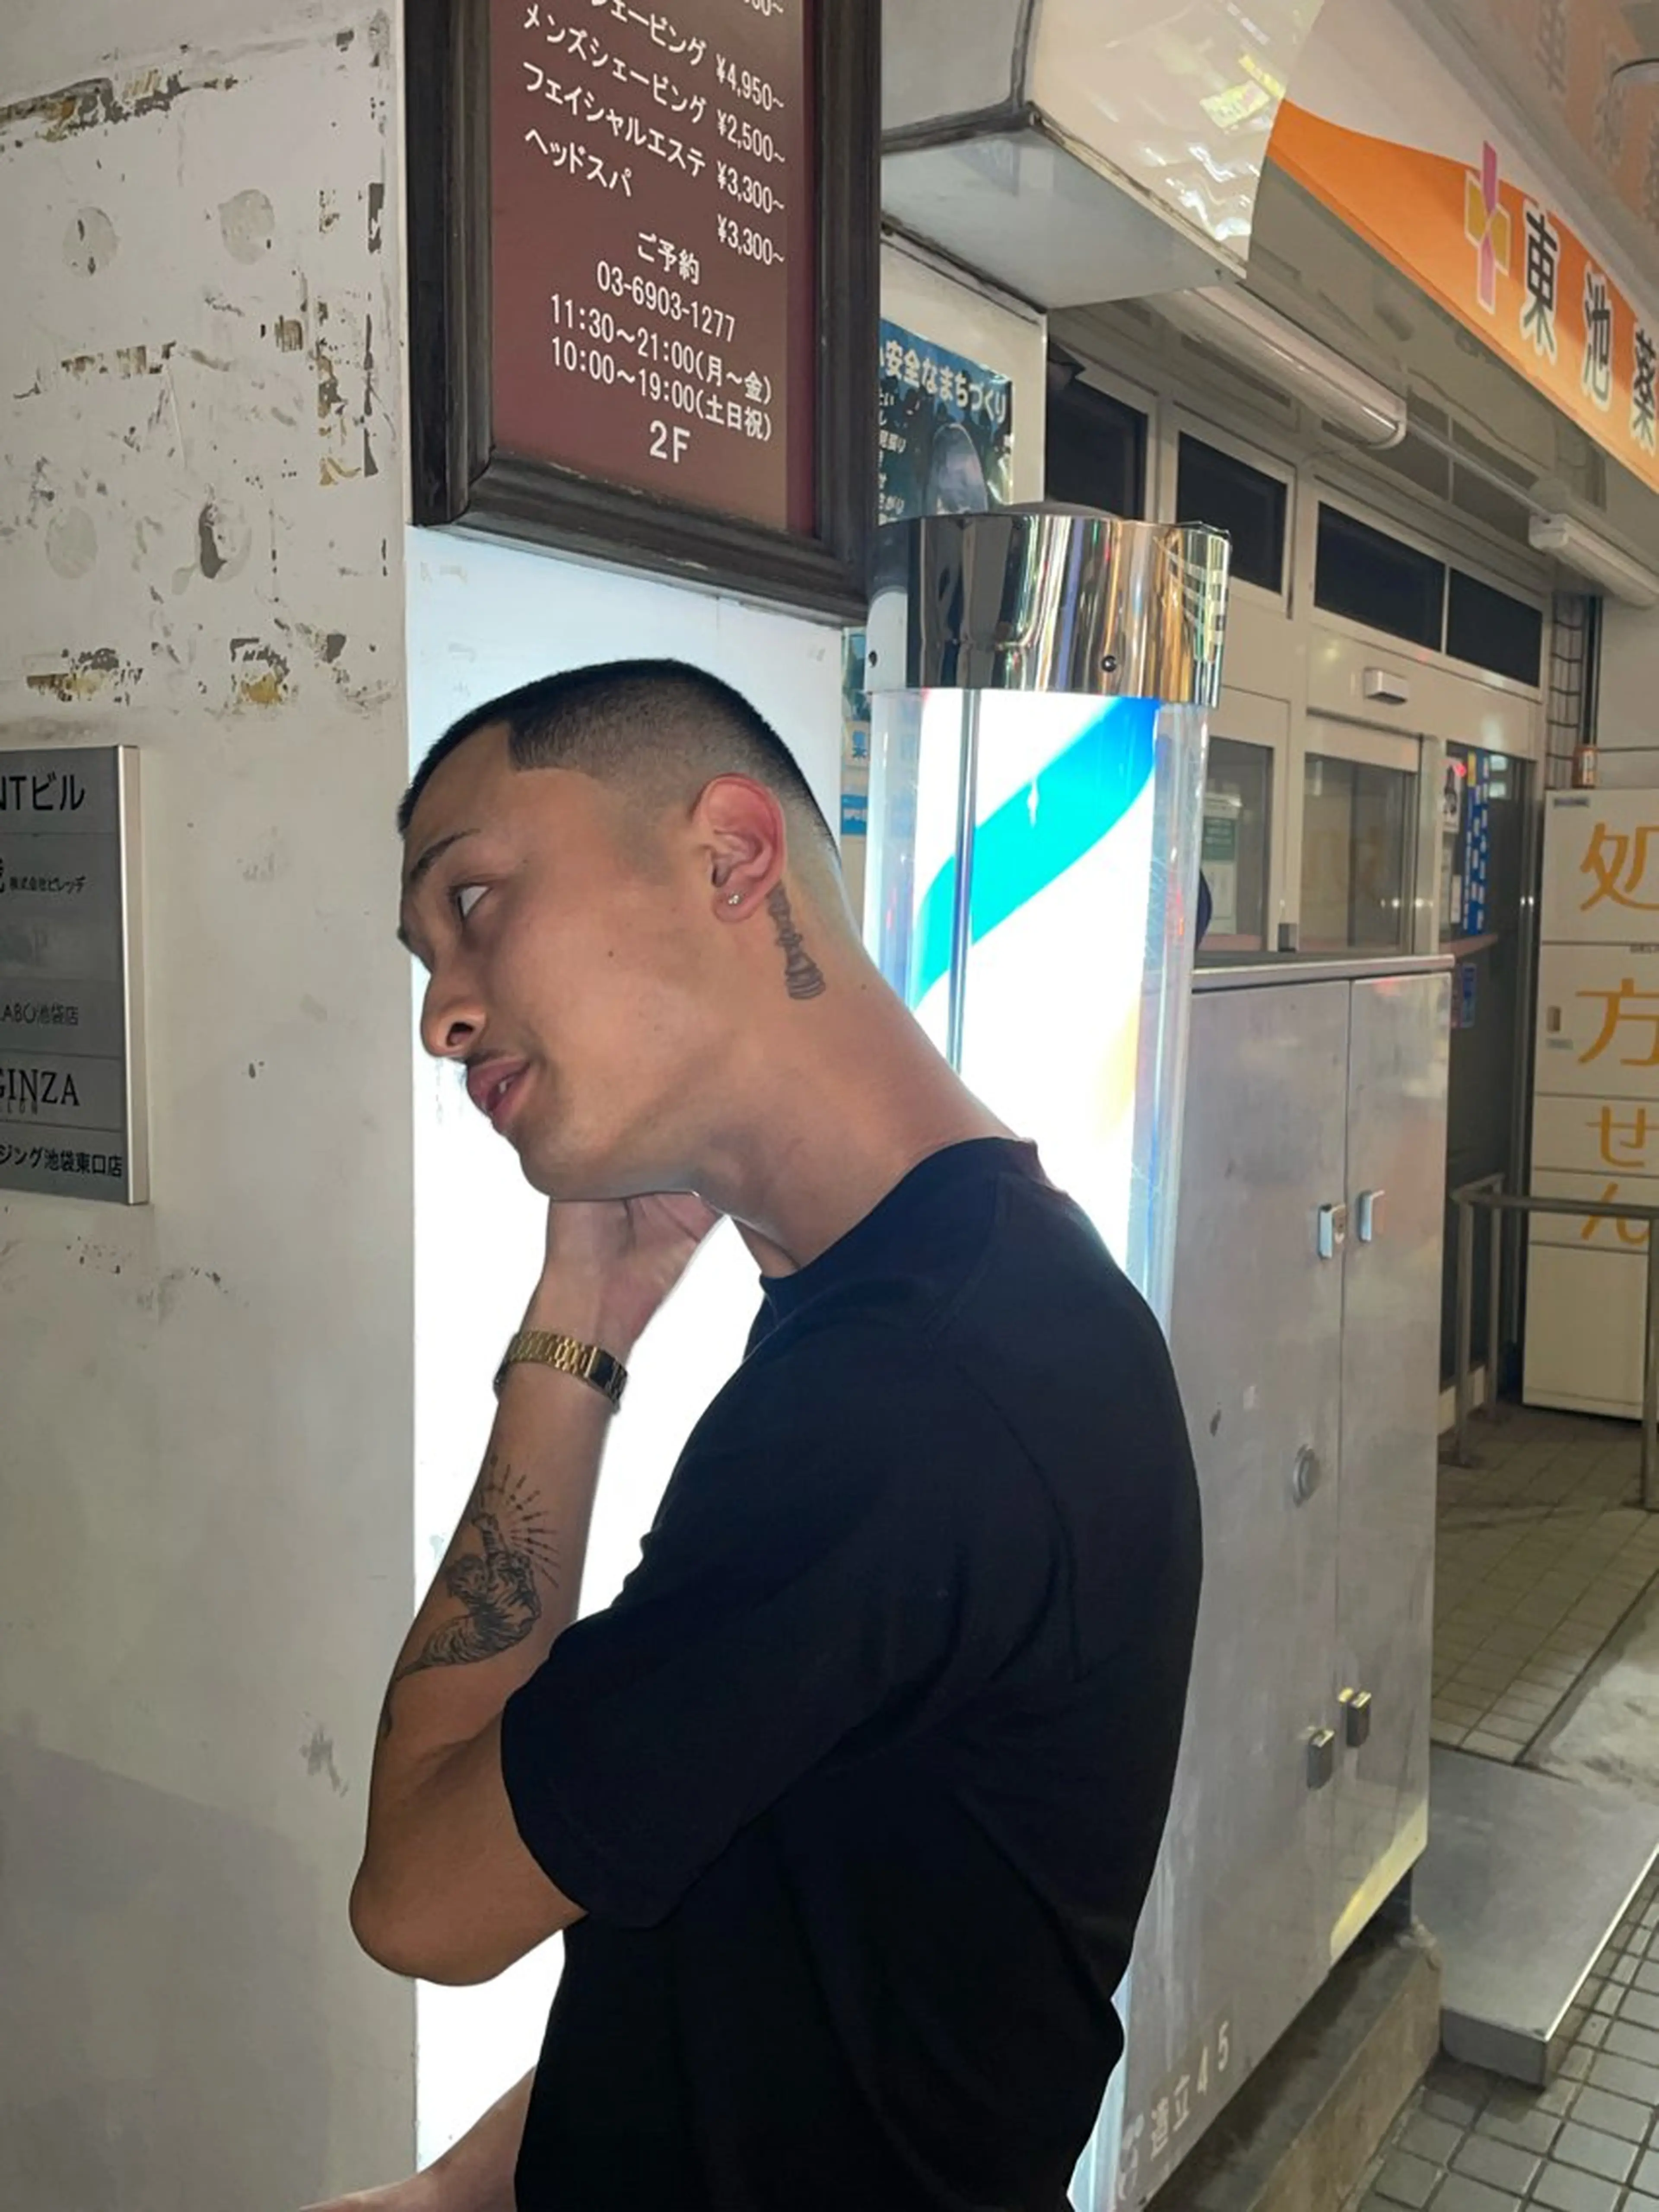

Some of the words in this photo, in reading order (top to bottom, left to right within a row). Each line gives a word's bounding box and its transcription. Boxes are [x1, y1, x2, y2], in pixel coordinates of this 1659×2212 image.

[523, 3, 707, 124] メンズシェービング
[717, 108, 785, 162] ¥2,500~
[591, 0, 707, 66] ェービング
[716, 54, 785, 111] ¥4,950~
[523, 62, 706, 178] フェイシャルエステ
[716, 160, 785, 214] ¥3,300~
[524, 129, 632, 197] ヘッドスパ
[717, 214, 785, 266] ¥3,300~
[597, 260, 735, 343] 03-6903-1277
[637, 232, 700, 285] ご予約
[649, 420, 691, 464] 2F
